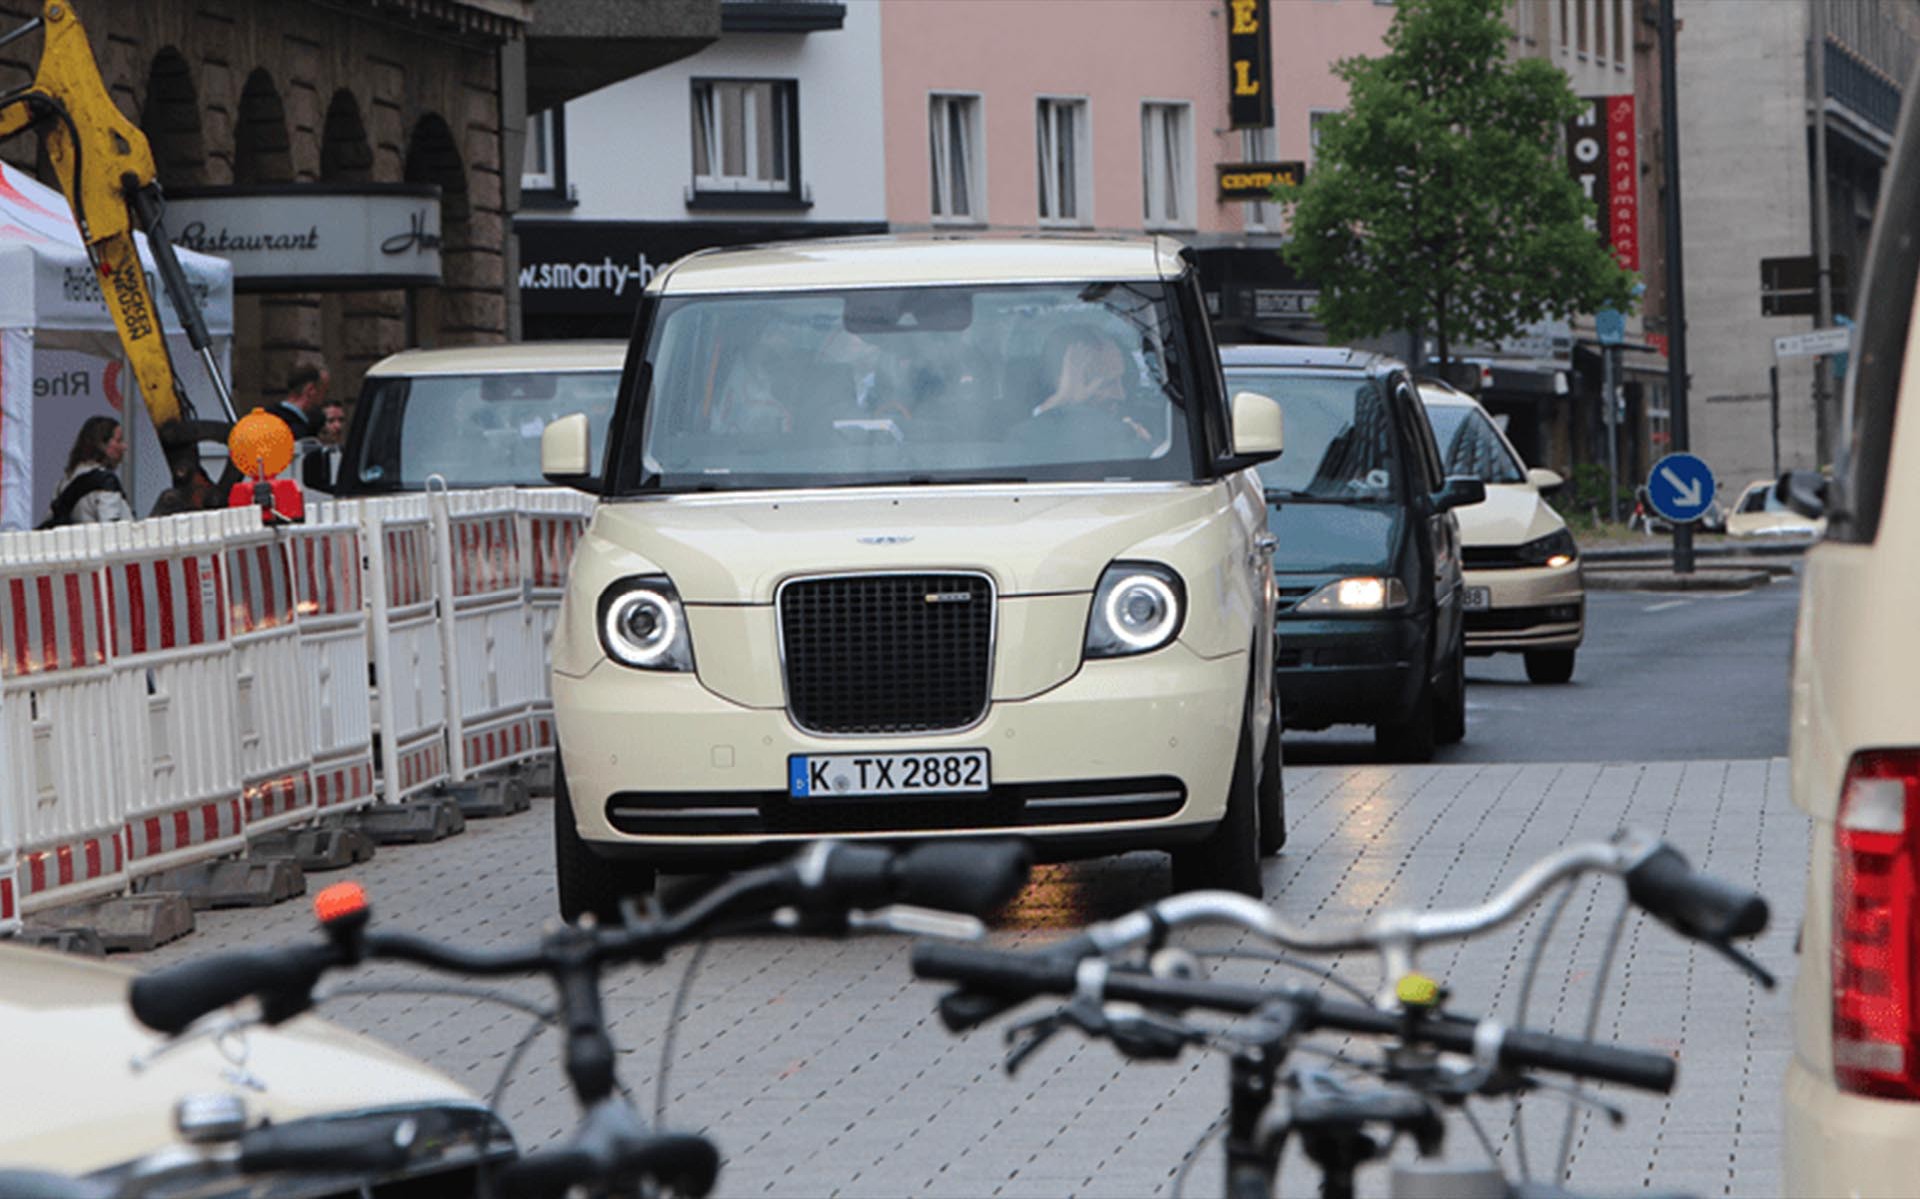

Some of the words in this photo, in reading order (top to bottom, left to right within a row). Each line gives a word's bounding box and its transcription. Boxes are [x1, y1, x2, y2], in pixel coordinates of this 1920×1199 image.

[172, 220, 319, 251] Restaurant
[122, 264, 153, 336] WACKER
[810, 760, 830, 791] K
